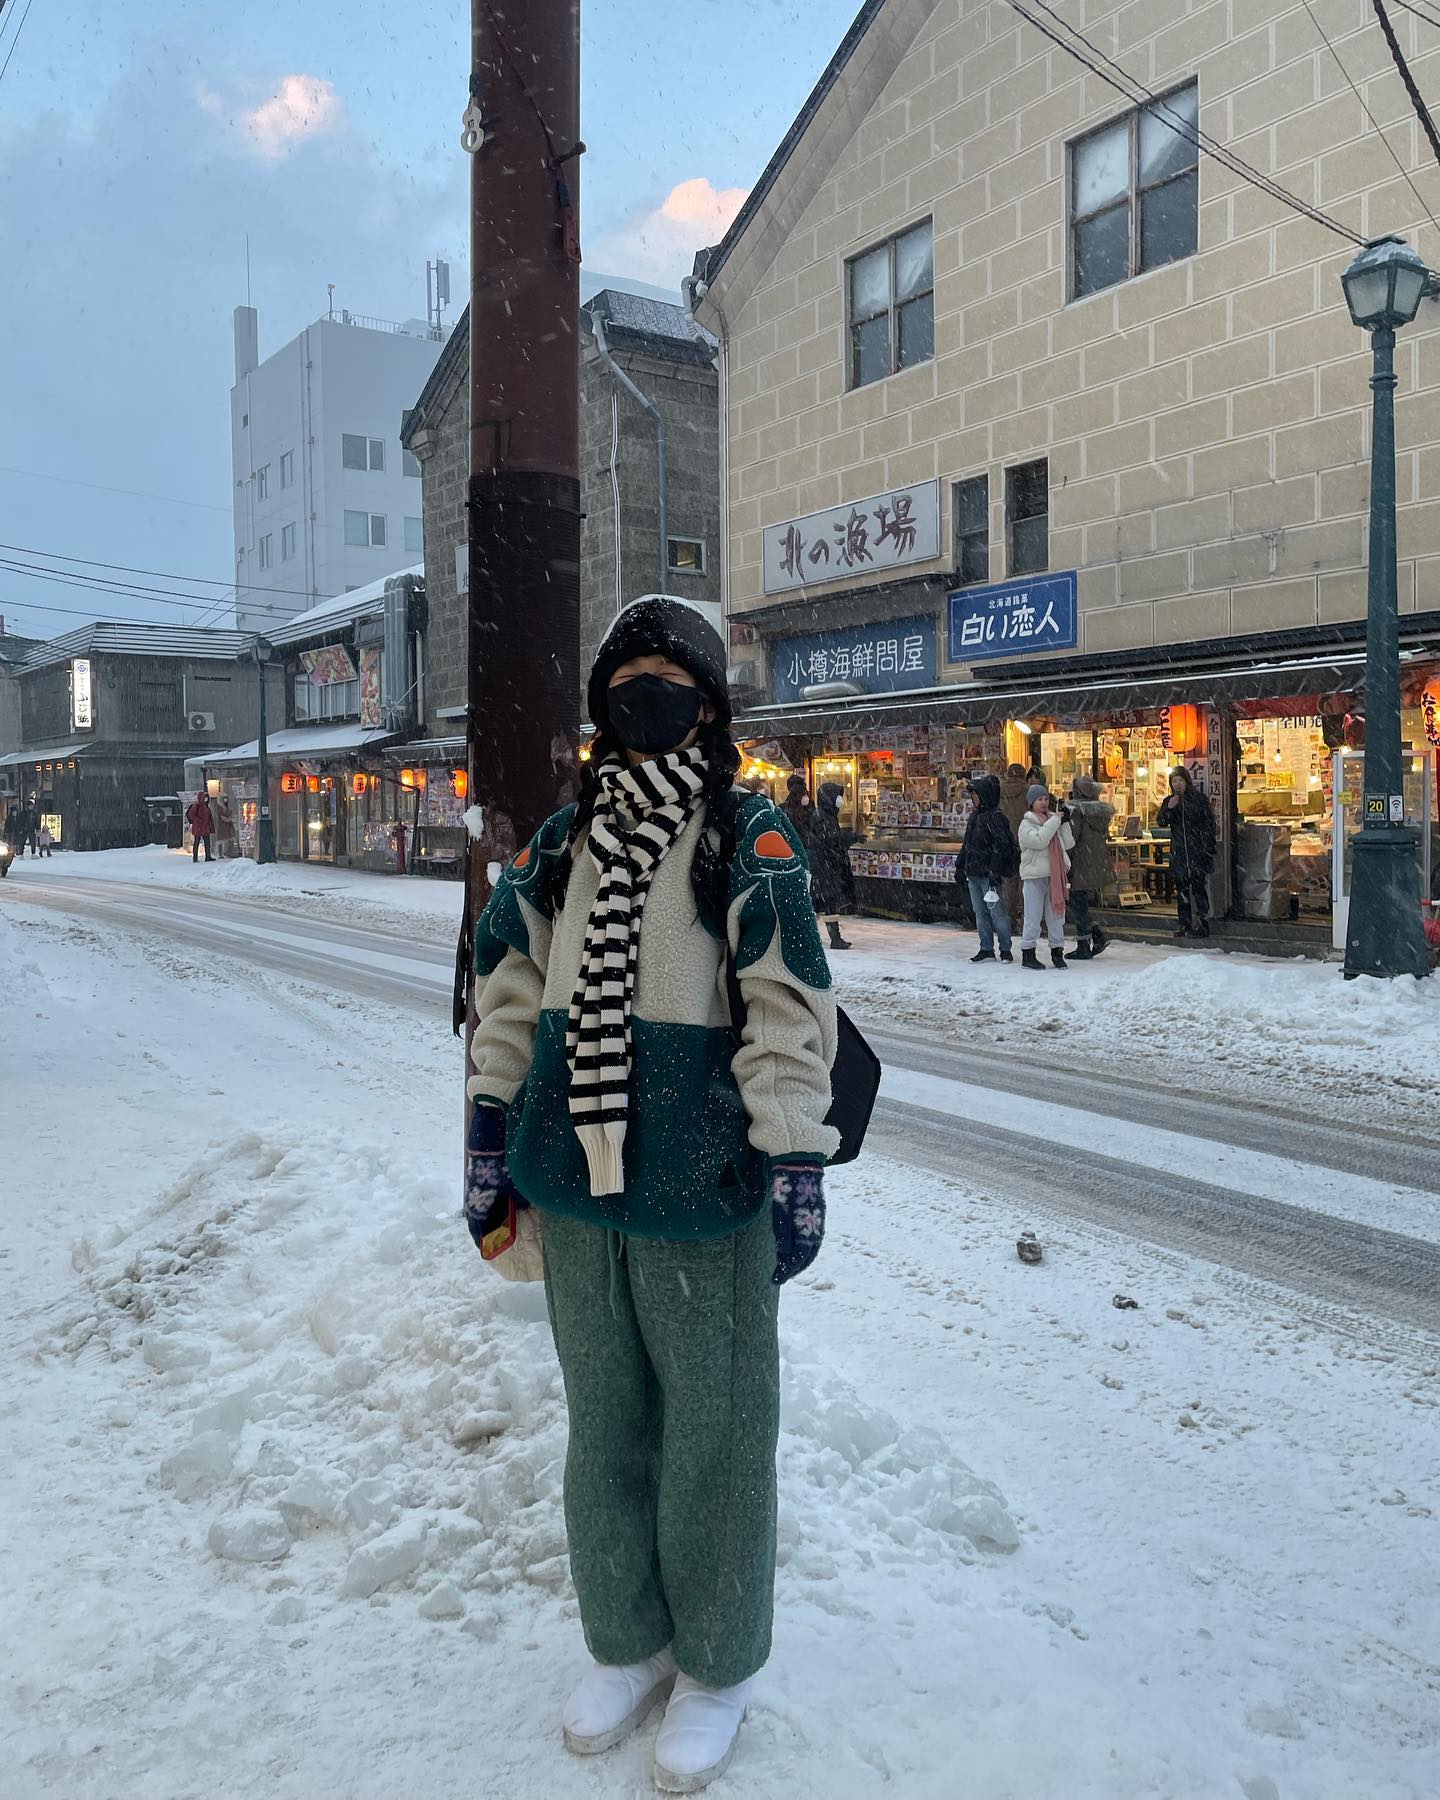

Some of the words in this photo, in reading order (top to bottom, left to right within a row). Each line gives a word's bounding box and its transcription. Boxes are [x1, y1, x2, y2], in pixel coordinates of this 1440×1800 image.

[779, 494, 917, 582] 北の漁場
[961, 601, 1060, 646] 白い恋人
[787, 635, 925, 686] 小樽海鮮問屋
[1208, 717, 1221, 796] 全国発送
[1369, 800, 1383, 812] 20
